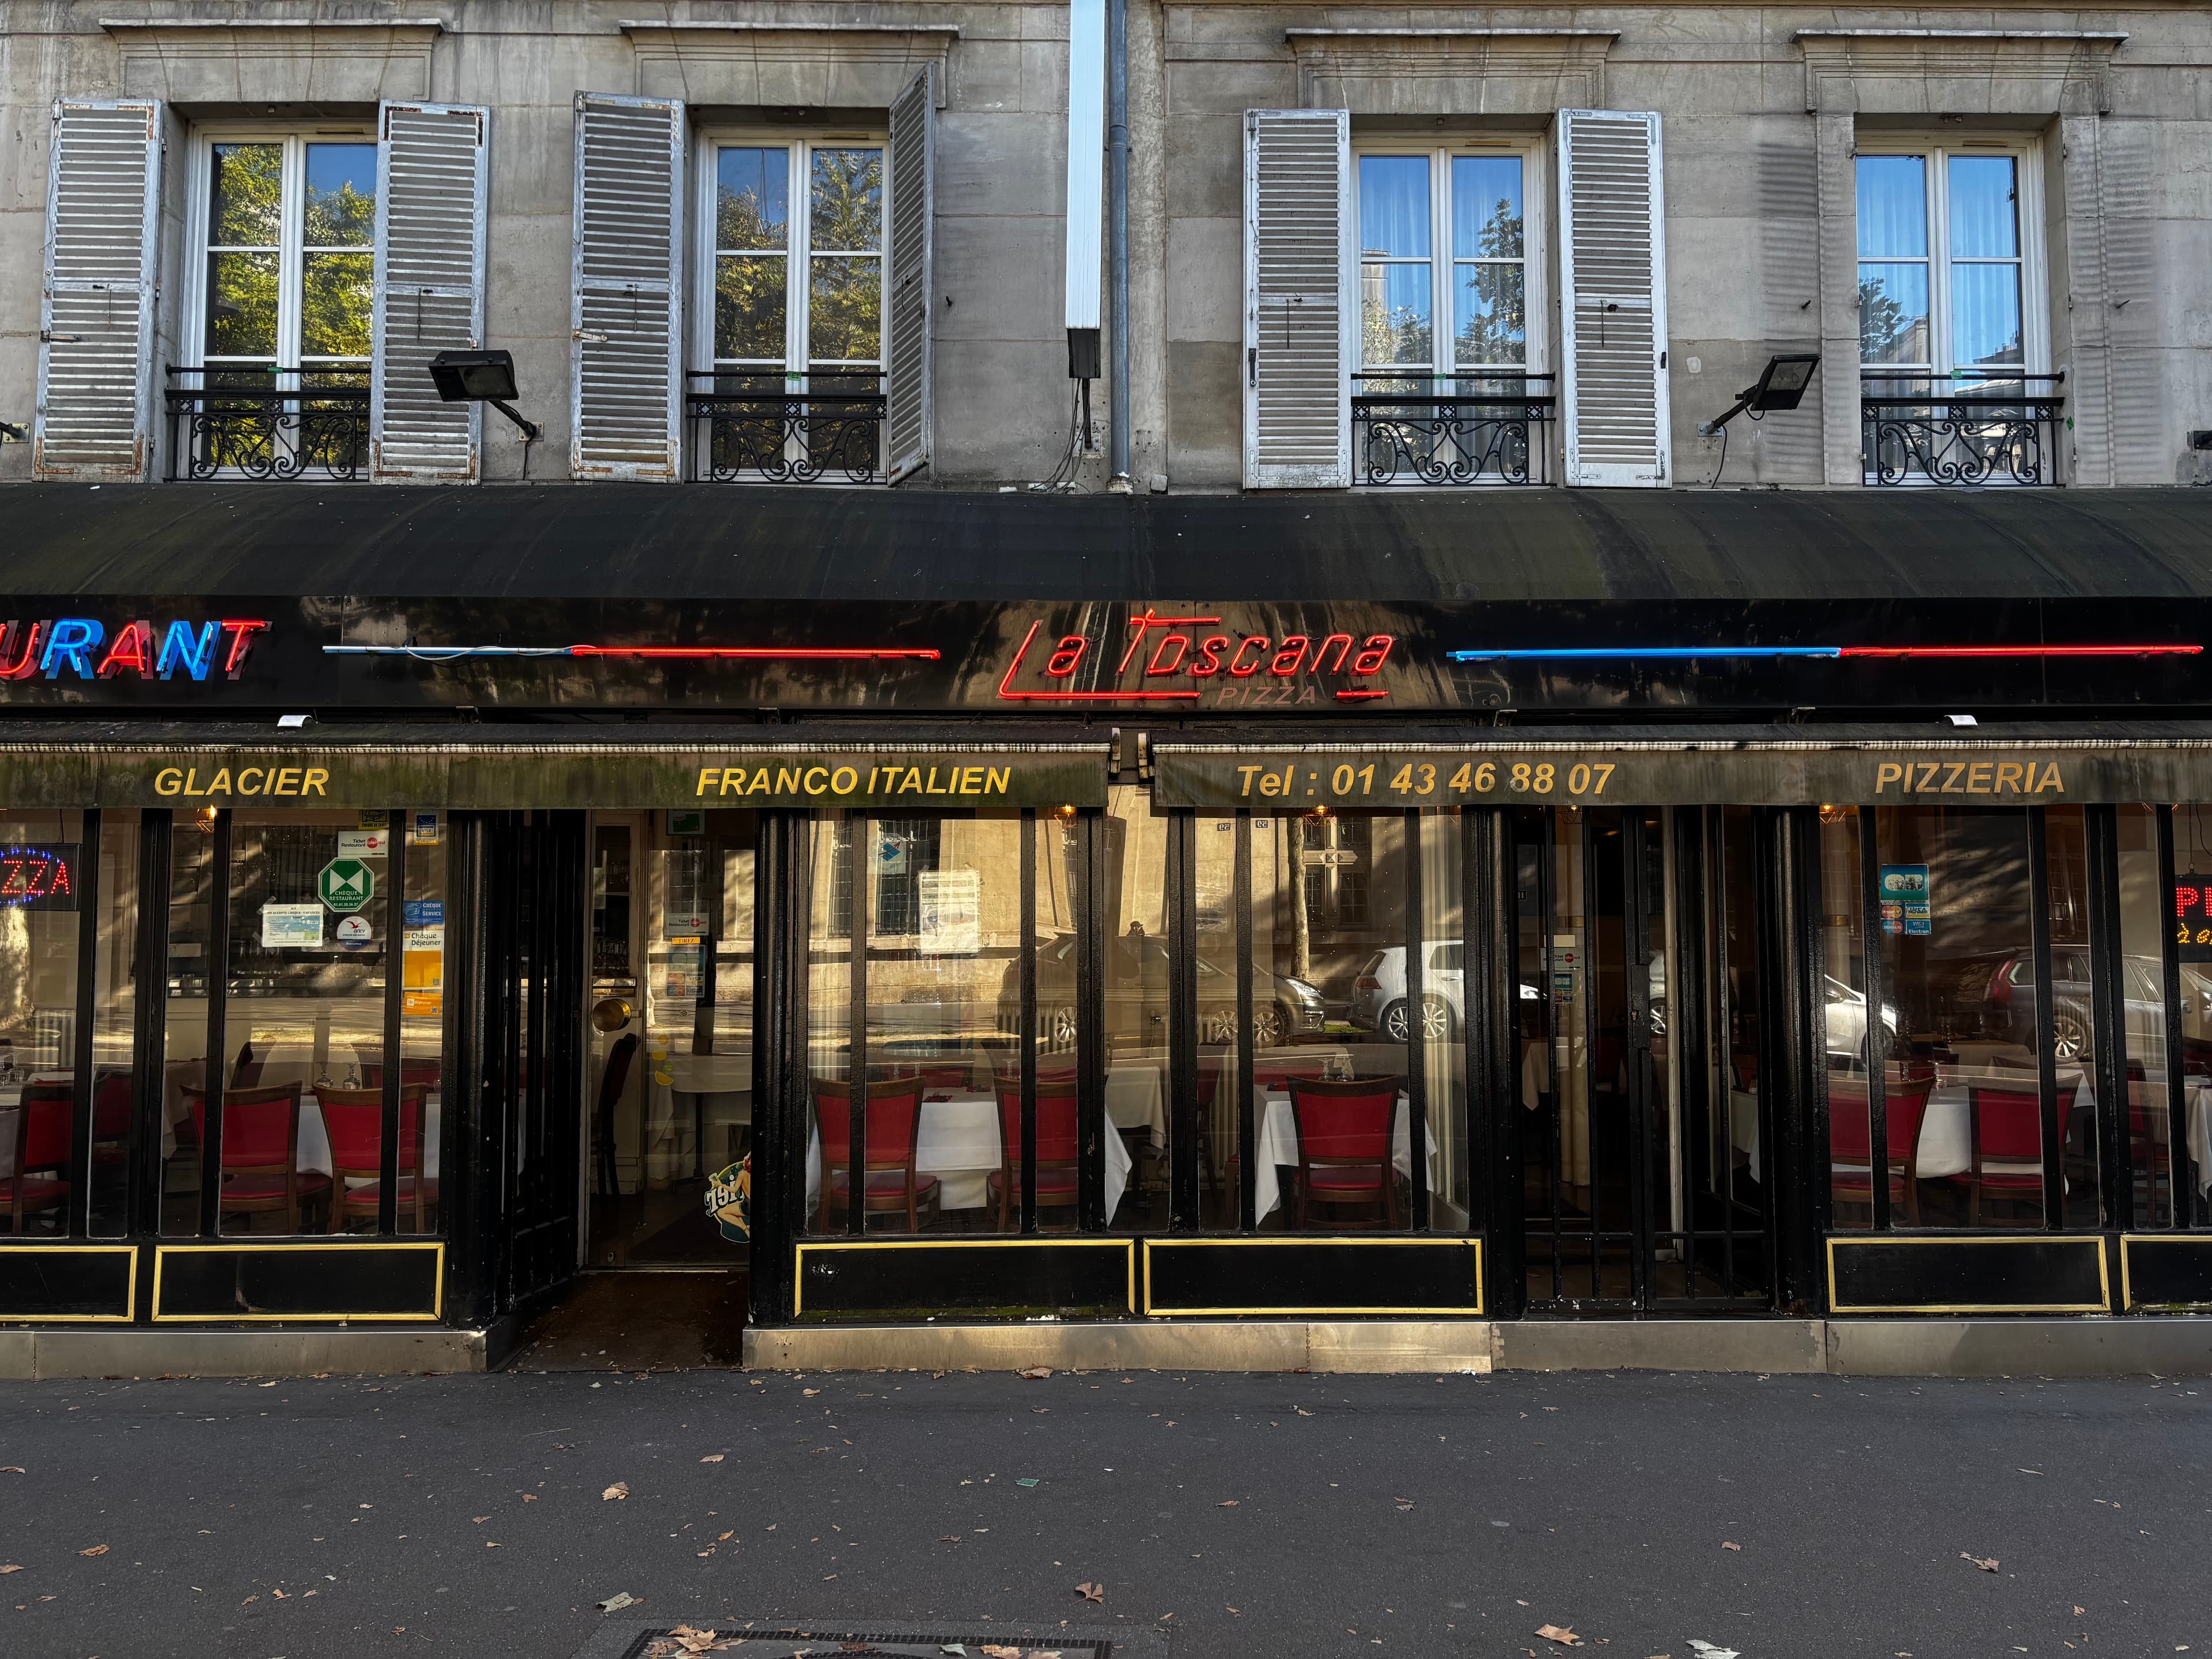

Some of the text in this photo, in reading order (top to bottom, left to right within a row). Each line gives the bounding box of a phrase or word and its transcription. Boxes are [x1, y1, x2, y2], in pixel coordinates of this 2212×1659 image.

[0, 619, 272, 681] URANT
[1116, 608, 1395, 677] Toscana
[1216, 685, 1316, 706] PIZZA
[154, 767, 329, 796] GLACIER
[696, 767, 1011, 796] FRANCO ITALIEN
[1237, 764, 1294, 796] Tel
[1332, 764, 1375, 796] 01
[1389, 763, 1435, 794] 43
[1448, 763, 1495, 793] 46
[1510, 763, 1554, 794] 88
[1568, 763, 1615, 794] 07
[1875, 762, 2064, 794] PIZZERIA
[1, 859, 70, 895] ZZA
